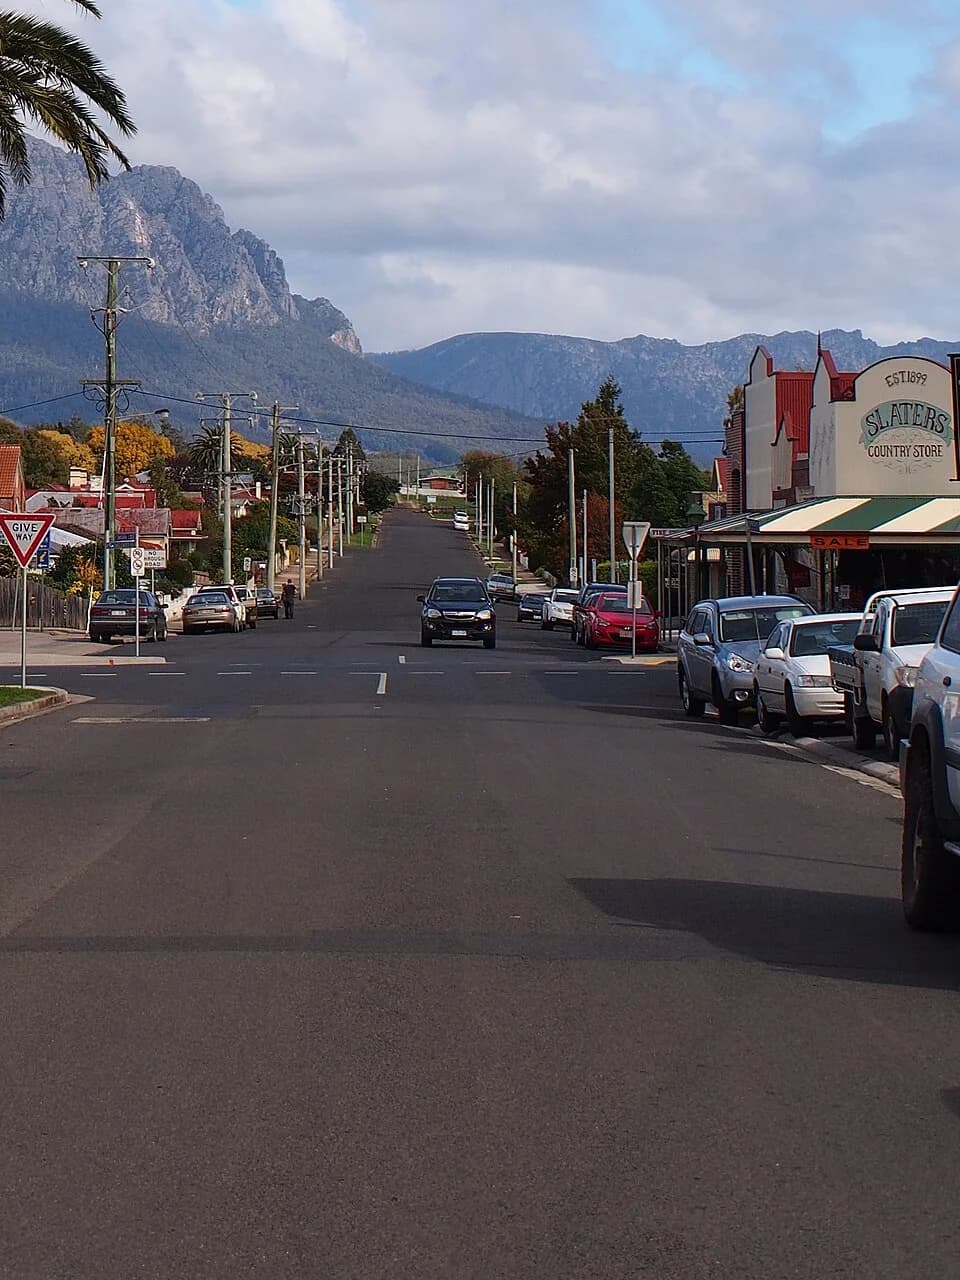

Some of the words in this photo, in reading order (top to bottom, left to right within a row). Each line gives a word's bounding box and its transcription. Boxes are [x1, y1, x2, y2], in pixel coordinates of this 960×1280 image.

[865, 402, 948, 437] SLATERS
[868, 444, 912, 458] COUNTRY
[912, 444, 944, 458] STORE
[12, 522, 38, 533] GIVE
[15, 533, 34, 541] WAY
[814, 537, 868, 546] SALE
